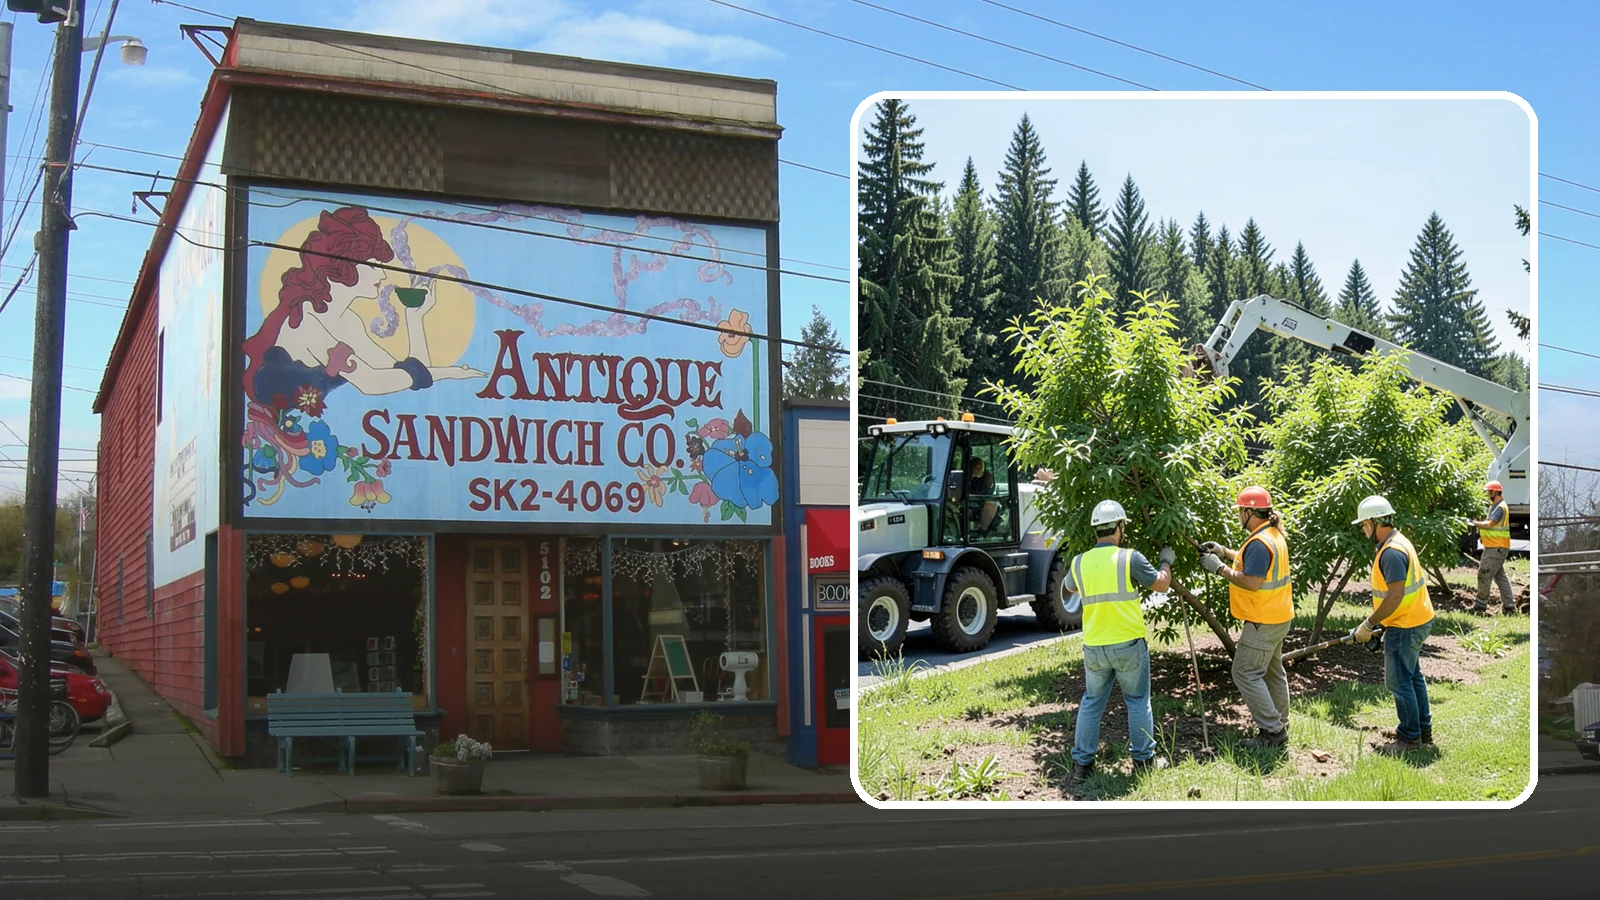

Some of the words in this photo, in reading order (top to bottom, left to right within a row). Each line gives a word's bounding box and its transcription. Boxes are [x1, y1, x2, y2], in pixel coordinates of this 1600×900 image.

[476, 329, 723, 421] ANTIQUE
[361, 409, 604, 466] SANDWICH
[617, 421, 685, 468] CO.
[468, 478, 646, 513] SK2-4069
[540, 541, 552, 599] 5102
[809, 555, 835, 568] BOOKS
